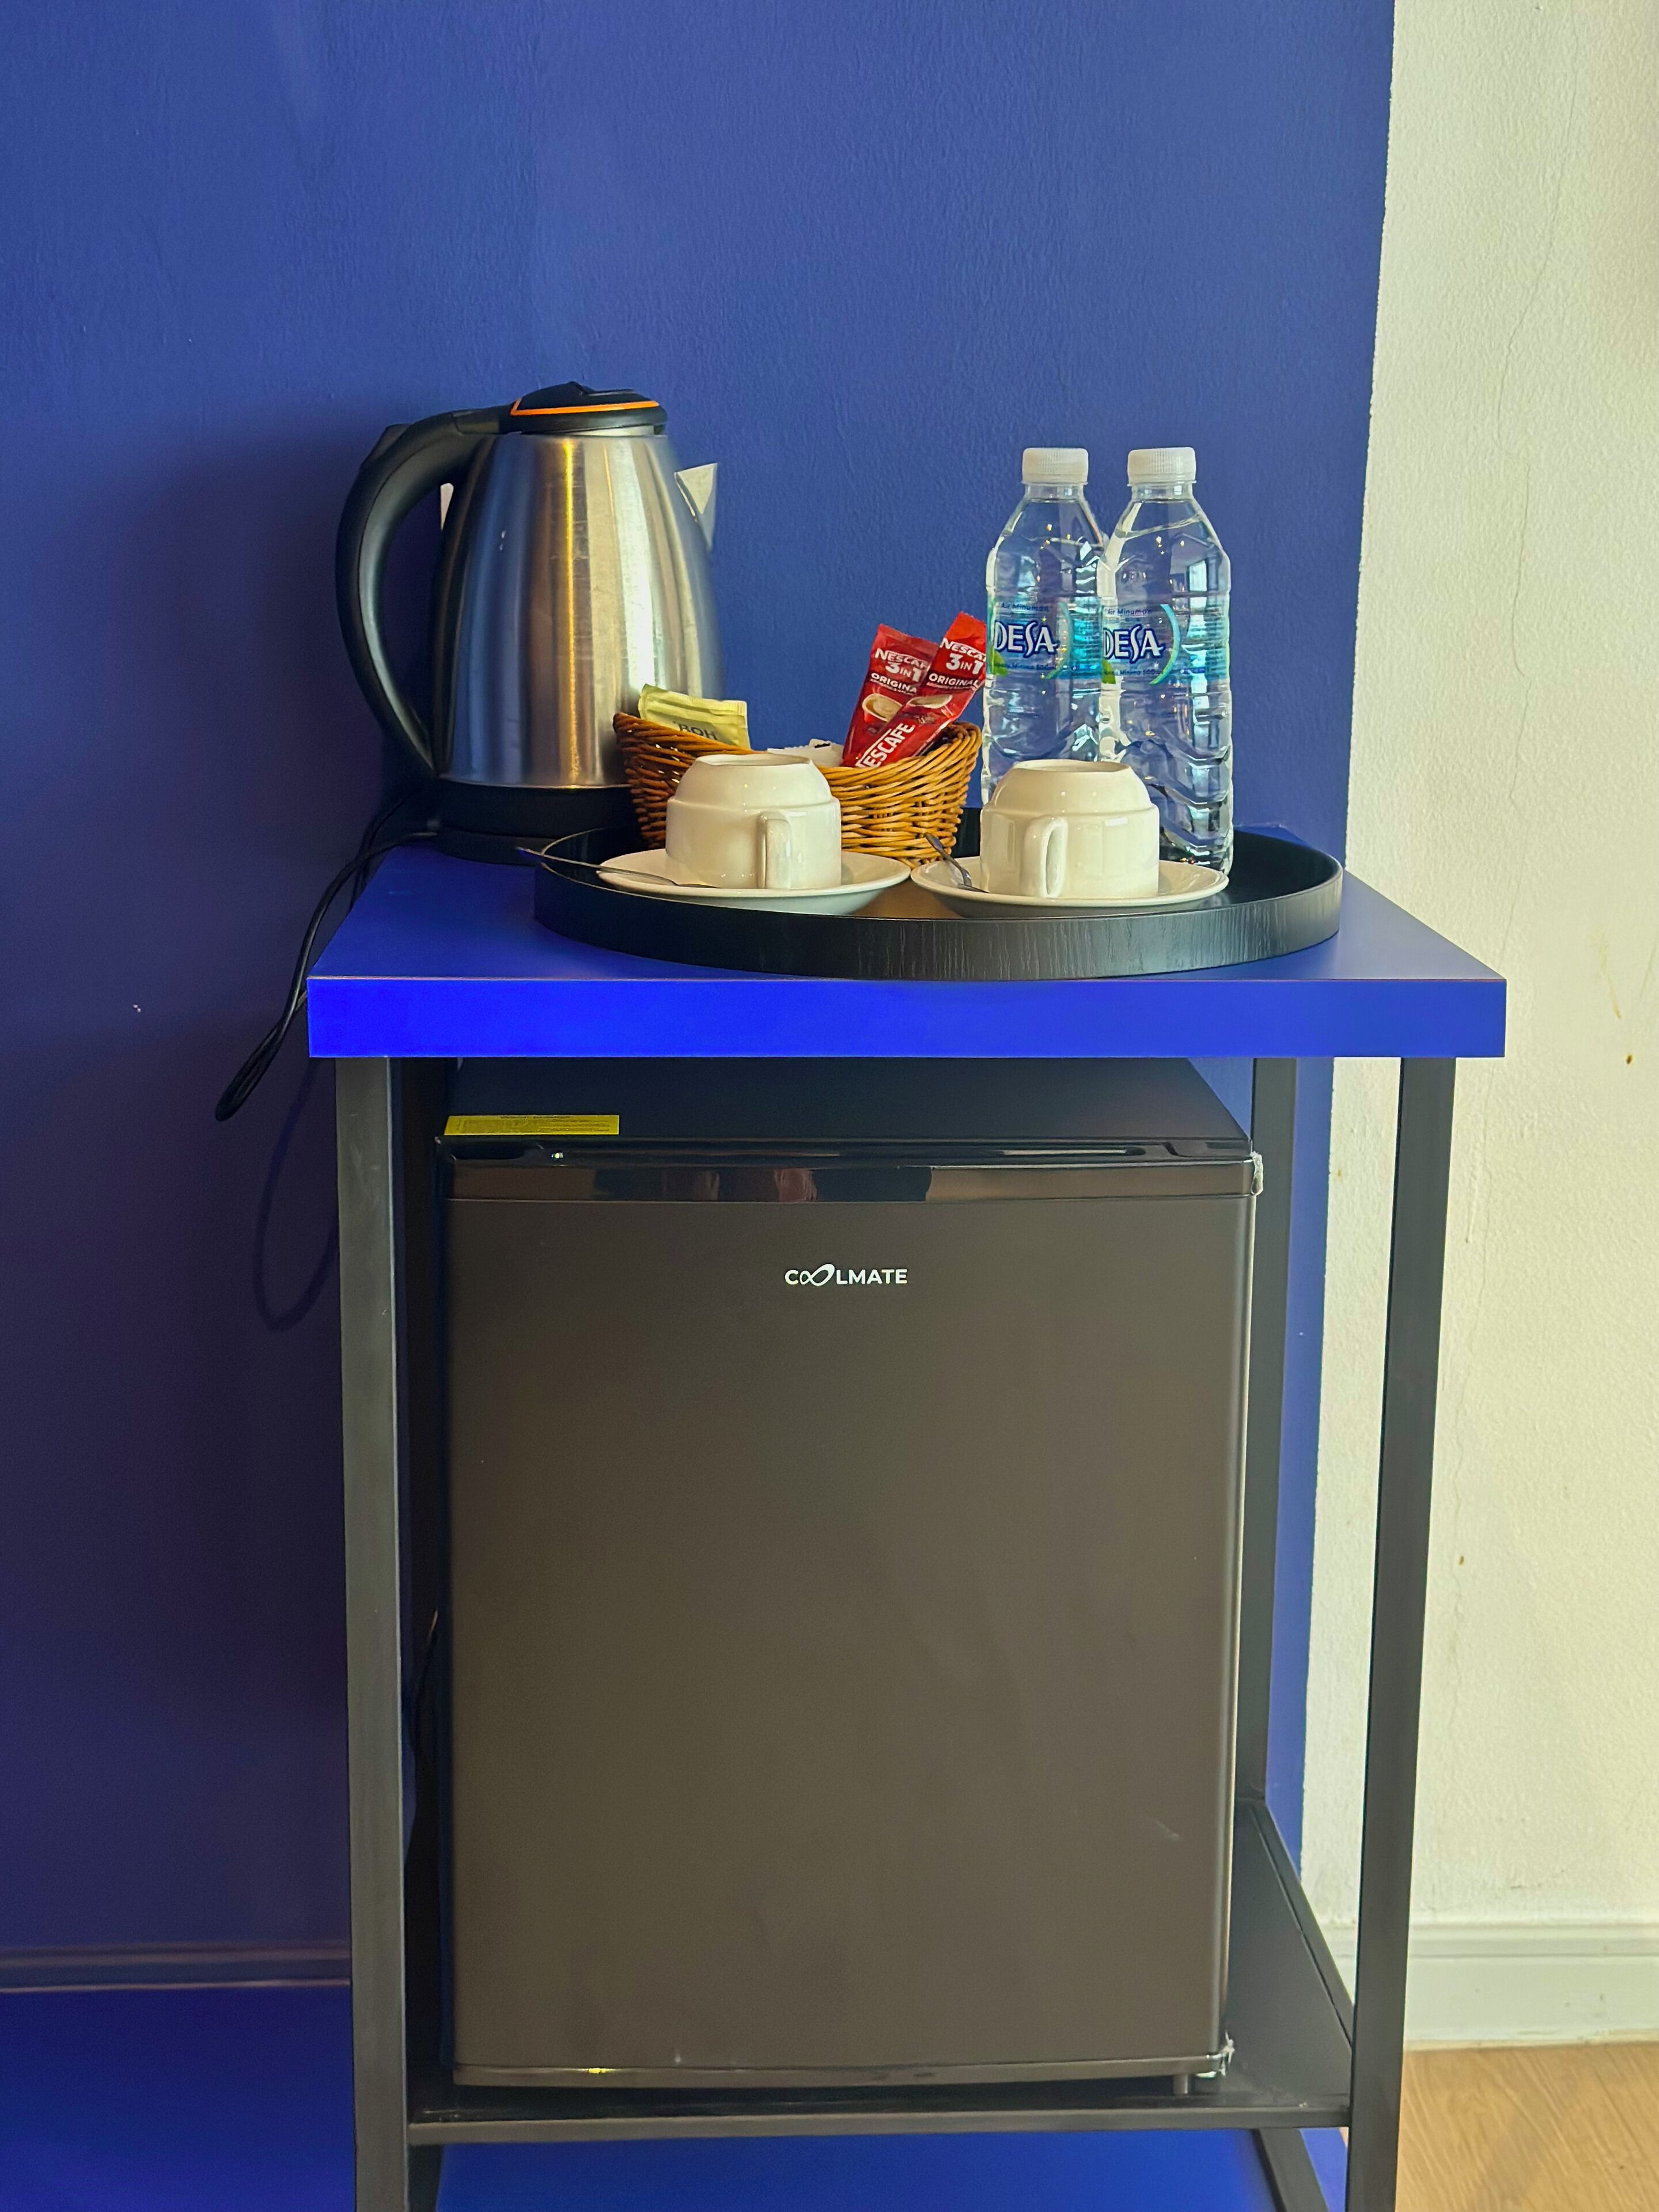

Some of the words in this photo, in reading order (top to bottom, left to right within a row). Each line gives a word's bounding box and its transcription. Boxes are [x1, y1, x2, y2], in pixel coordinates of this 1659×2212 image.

[940, 637, 987, 662] NESCA
[994, 620, 1059, 657] DESA
[1103, 624, 1165, 663] DESA
[875, 648, 930, 670] NESCAF
[946, 653, 963, 670] 3
[960, 661, 973, 671] IN
[972, 660, 984, 675] 1
[871, 672, 918, 693] ORIGINA
[885, 662, 900, 673] 3
[900, 668, 911, 677] IN
[912, 667, 922, 682] 1
[929, 673, 979, 688] ORIGINAL
[785, 1263, 907, 1286] COOLMATE
